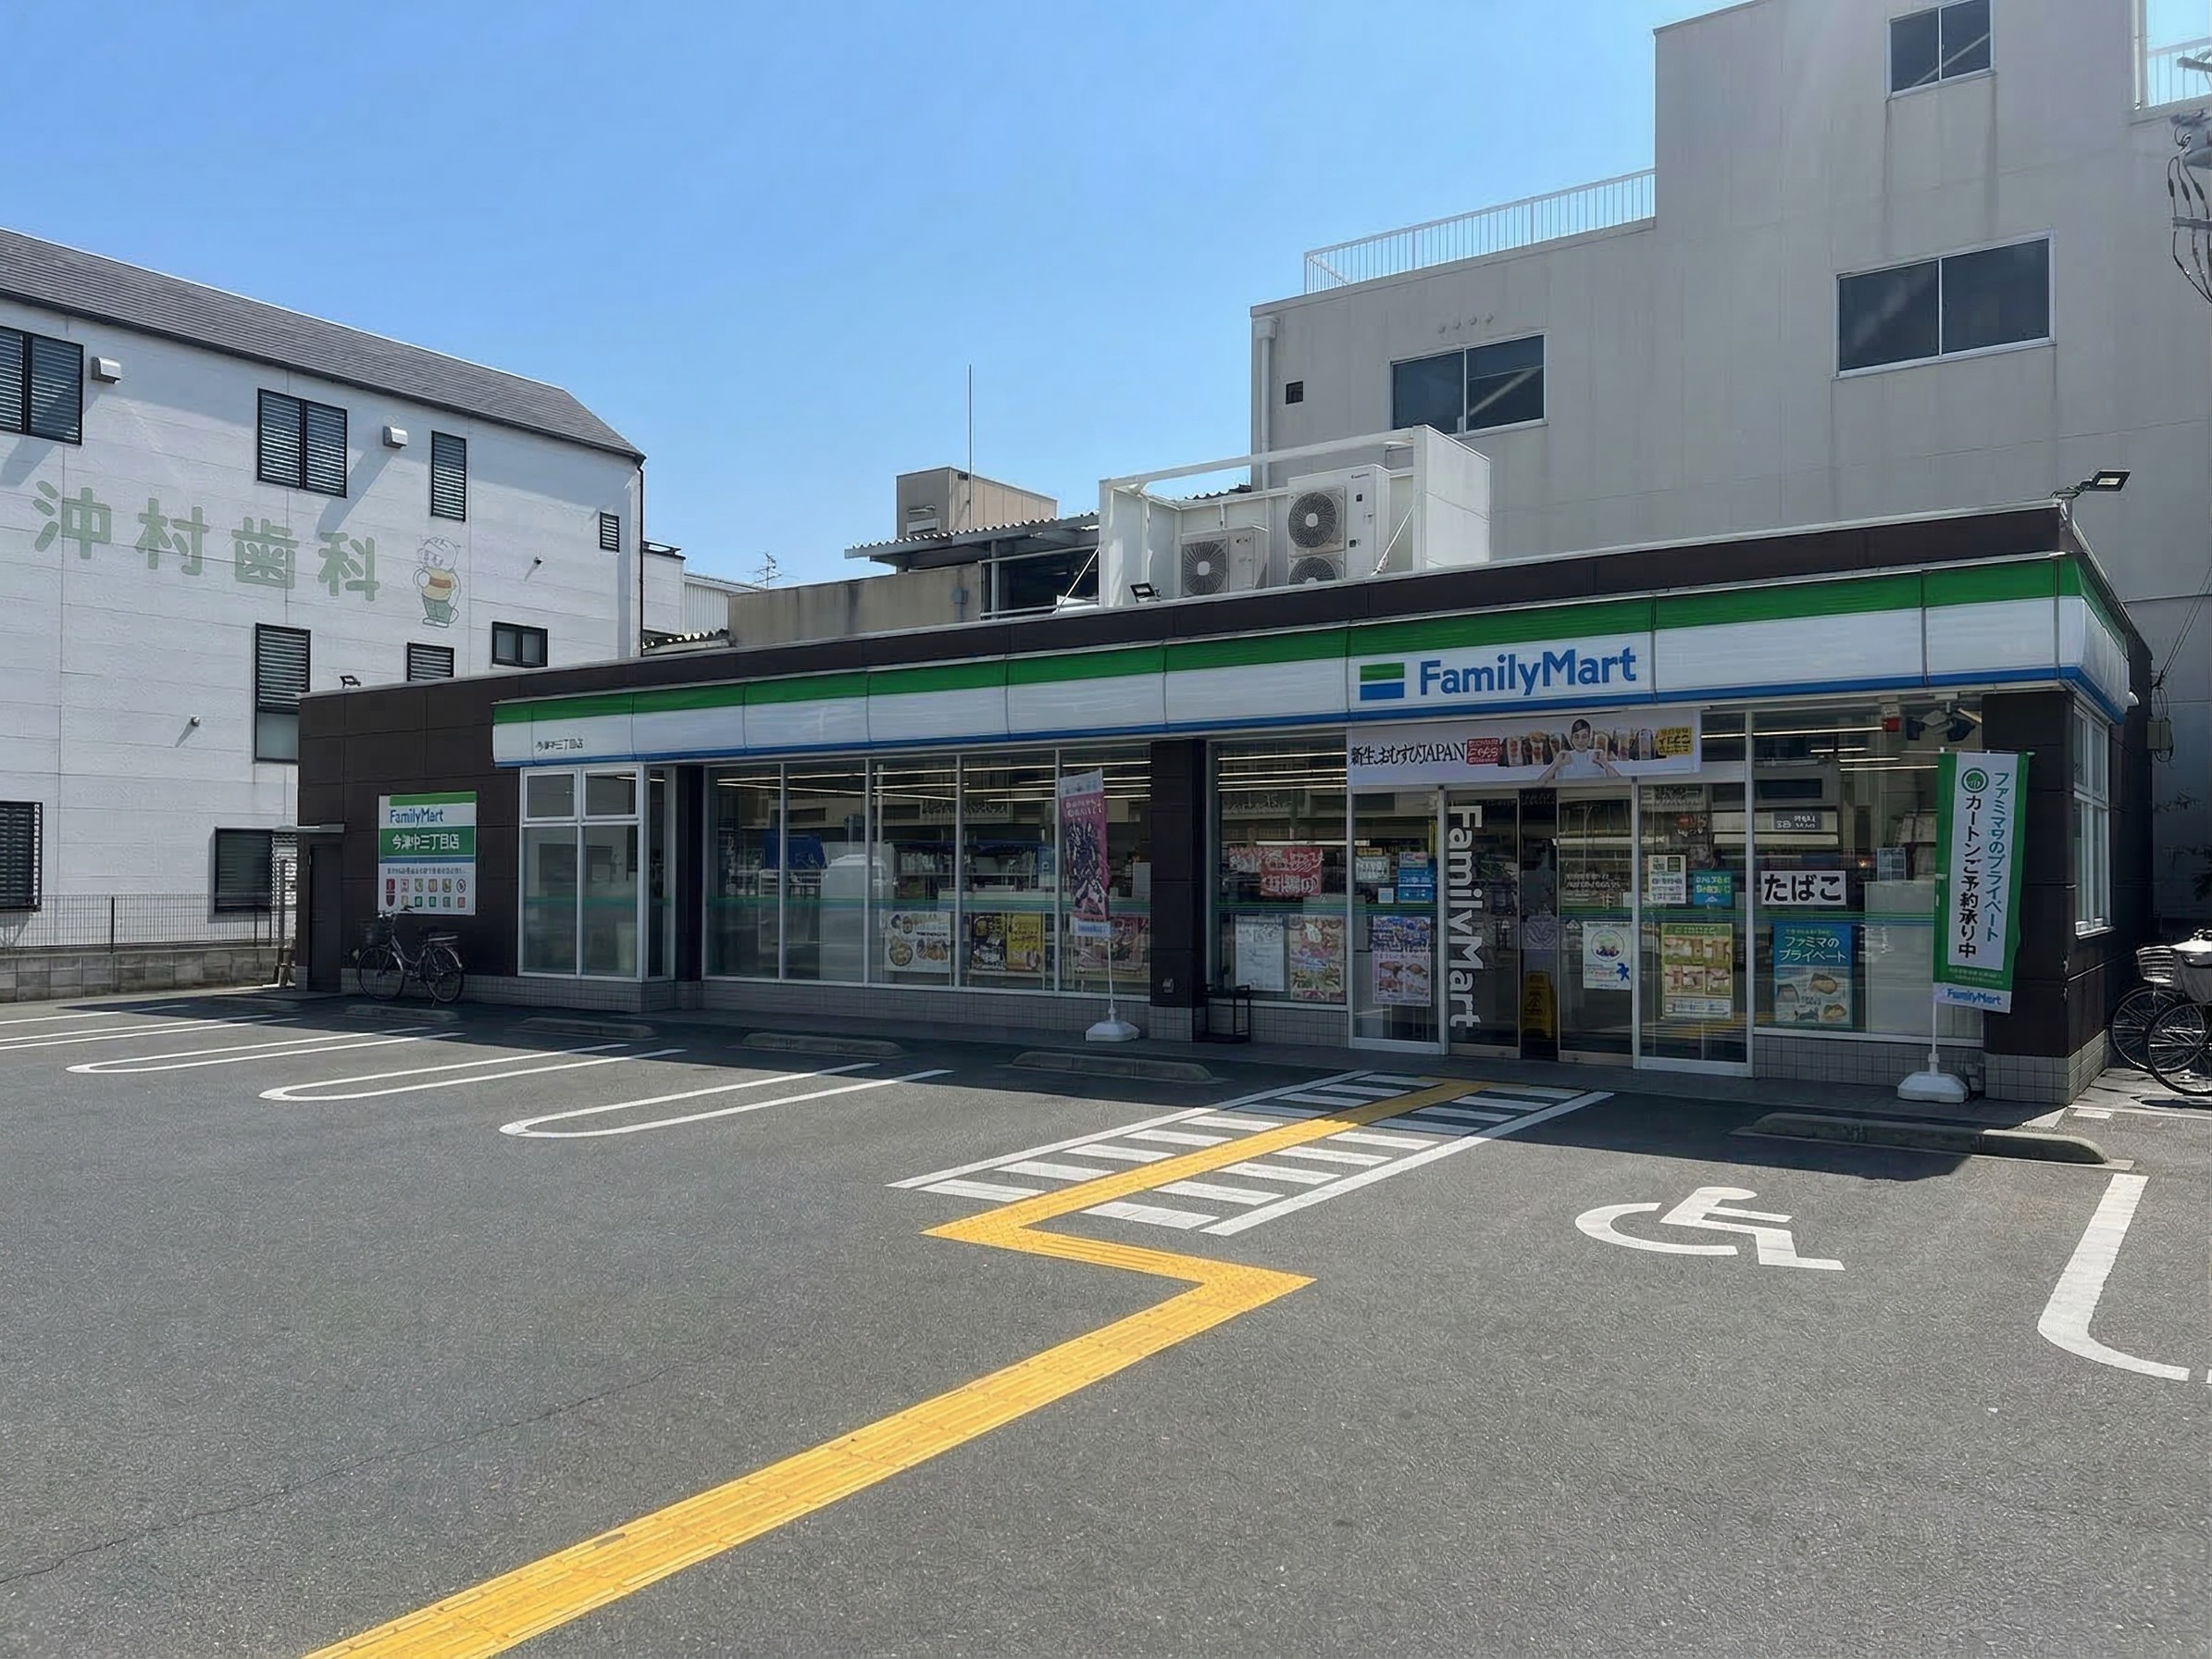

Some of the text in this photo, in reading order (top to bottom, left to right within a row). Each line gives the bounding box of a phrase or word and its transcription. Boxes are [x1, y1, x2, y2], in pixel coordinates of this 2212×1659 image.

[33, 480, 380, 602] 沖村歯科
[1419, 646, 1637, 696] FamilyMart
[390, 807, 444, 828] FamilyMart
[391, 833, 460, 851] 今津中三丁目店
[1764, 873, 1842, 903] たばこ
[1957, 794, 1982, 959] カートンご予約承り中
[1448, 805, 1484, 1028] FamilyMart
